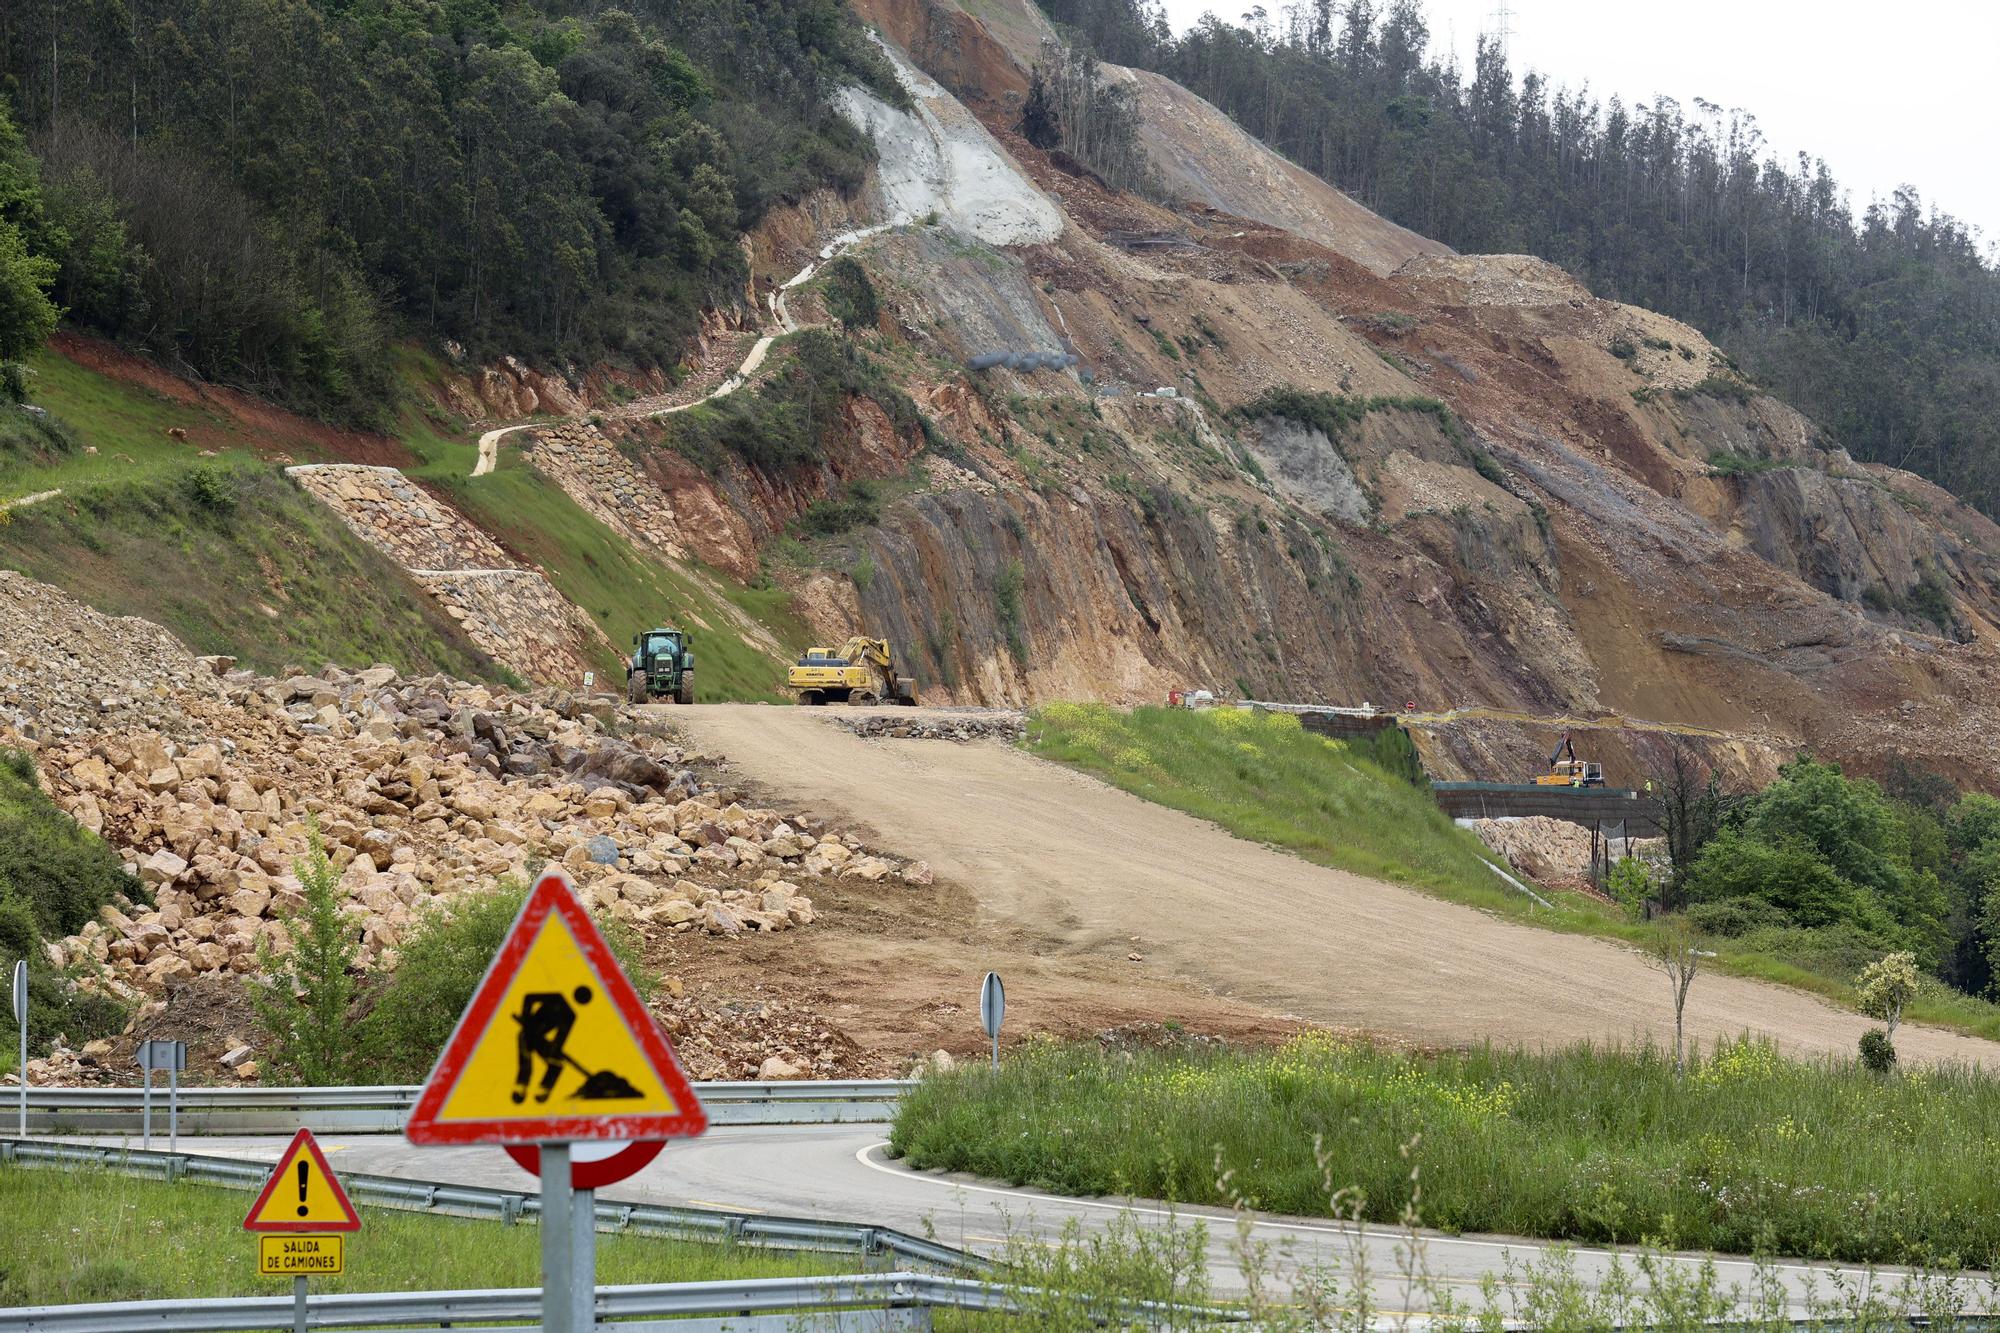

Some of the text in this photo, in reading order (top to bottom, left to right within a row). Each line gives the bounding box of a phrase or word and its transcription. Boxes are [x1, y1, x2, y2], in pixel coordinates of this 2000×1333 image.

[284, 1241, 319, 1253] SALIDA
[268, 1256, 334, 1268] DE CAMIONES
